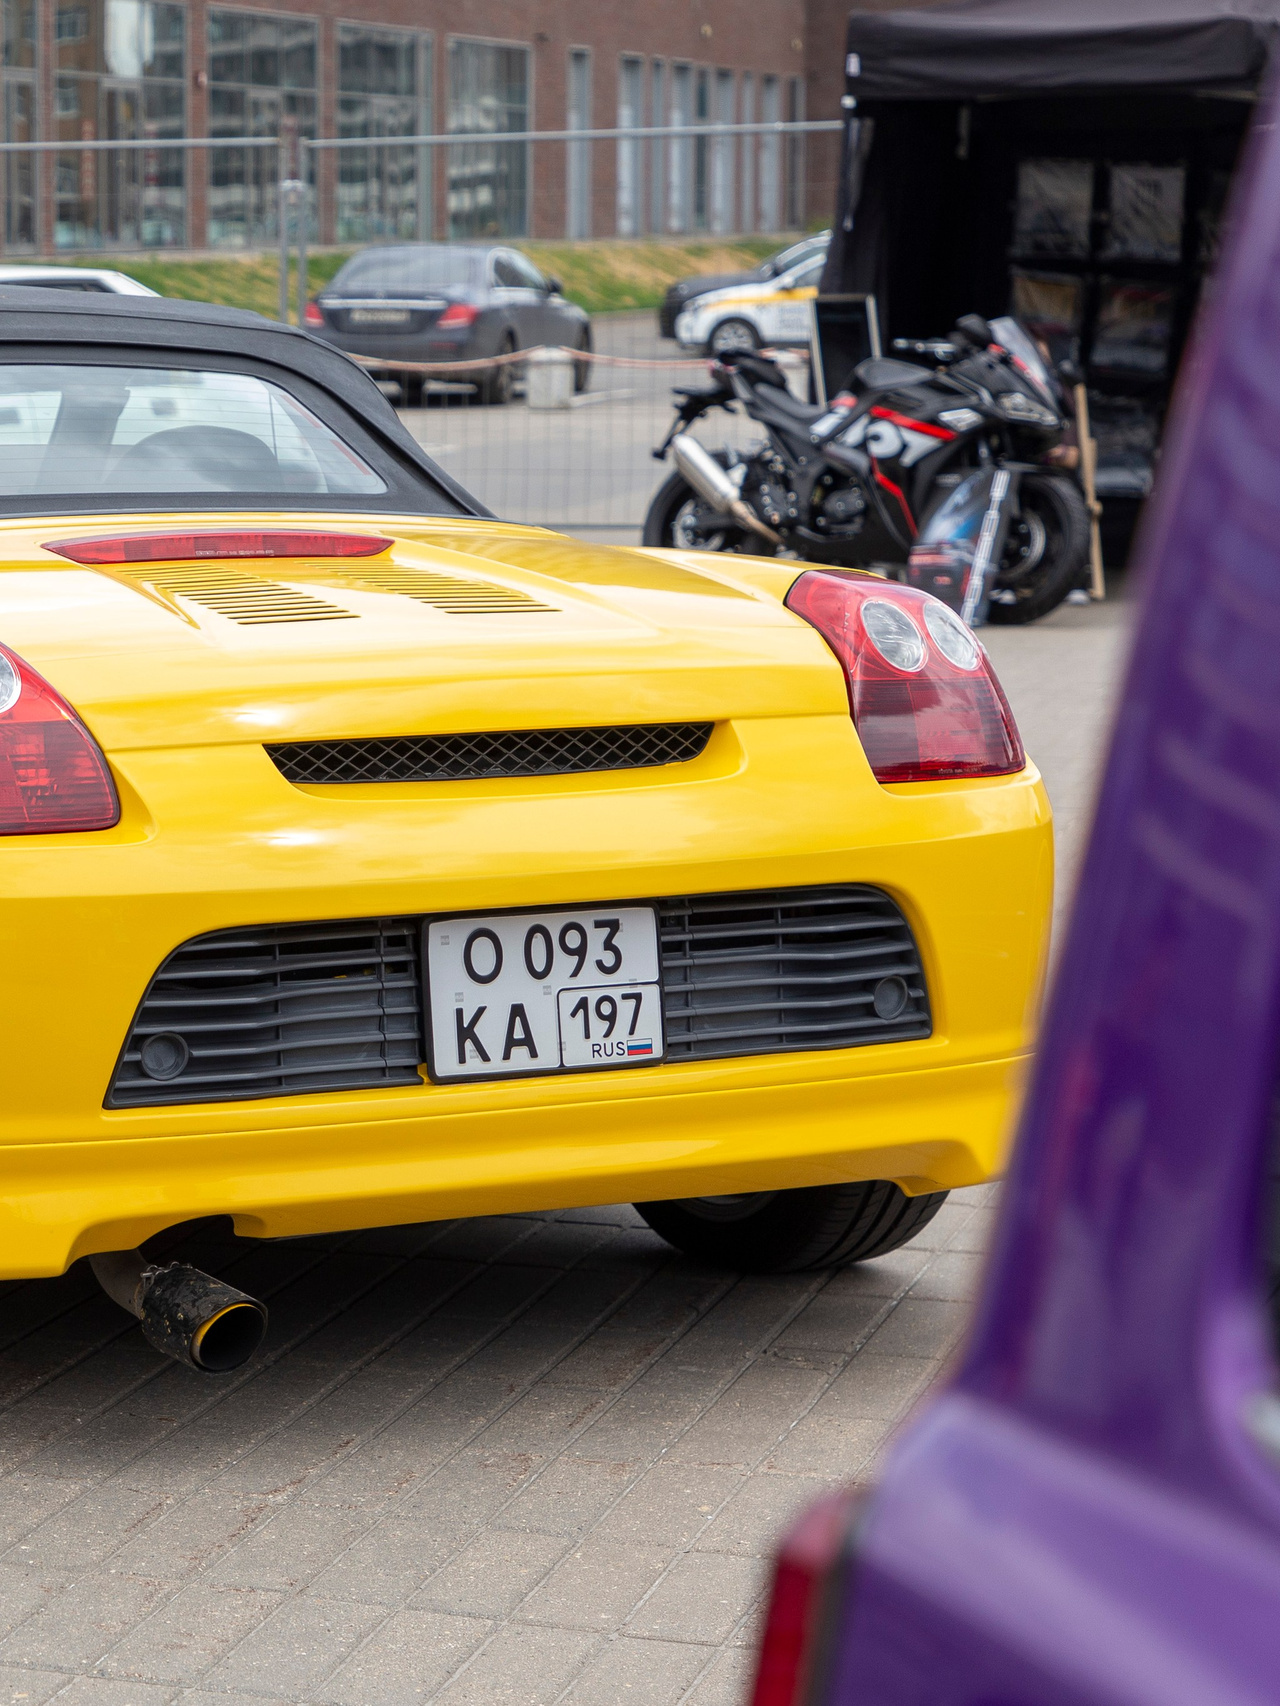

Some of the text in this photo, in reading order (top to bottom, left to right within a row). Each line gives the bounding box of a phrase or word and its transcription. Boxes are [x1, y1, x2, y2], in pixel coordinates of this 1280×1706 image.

[463, 918, 623, 985] O 093
[455, 1002, 539, 1065] KA
[569, 992, 643, 1040] 197
[592, 1041, 626, 1059] RUS
